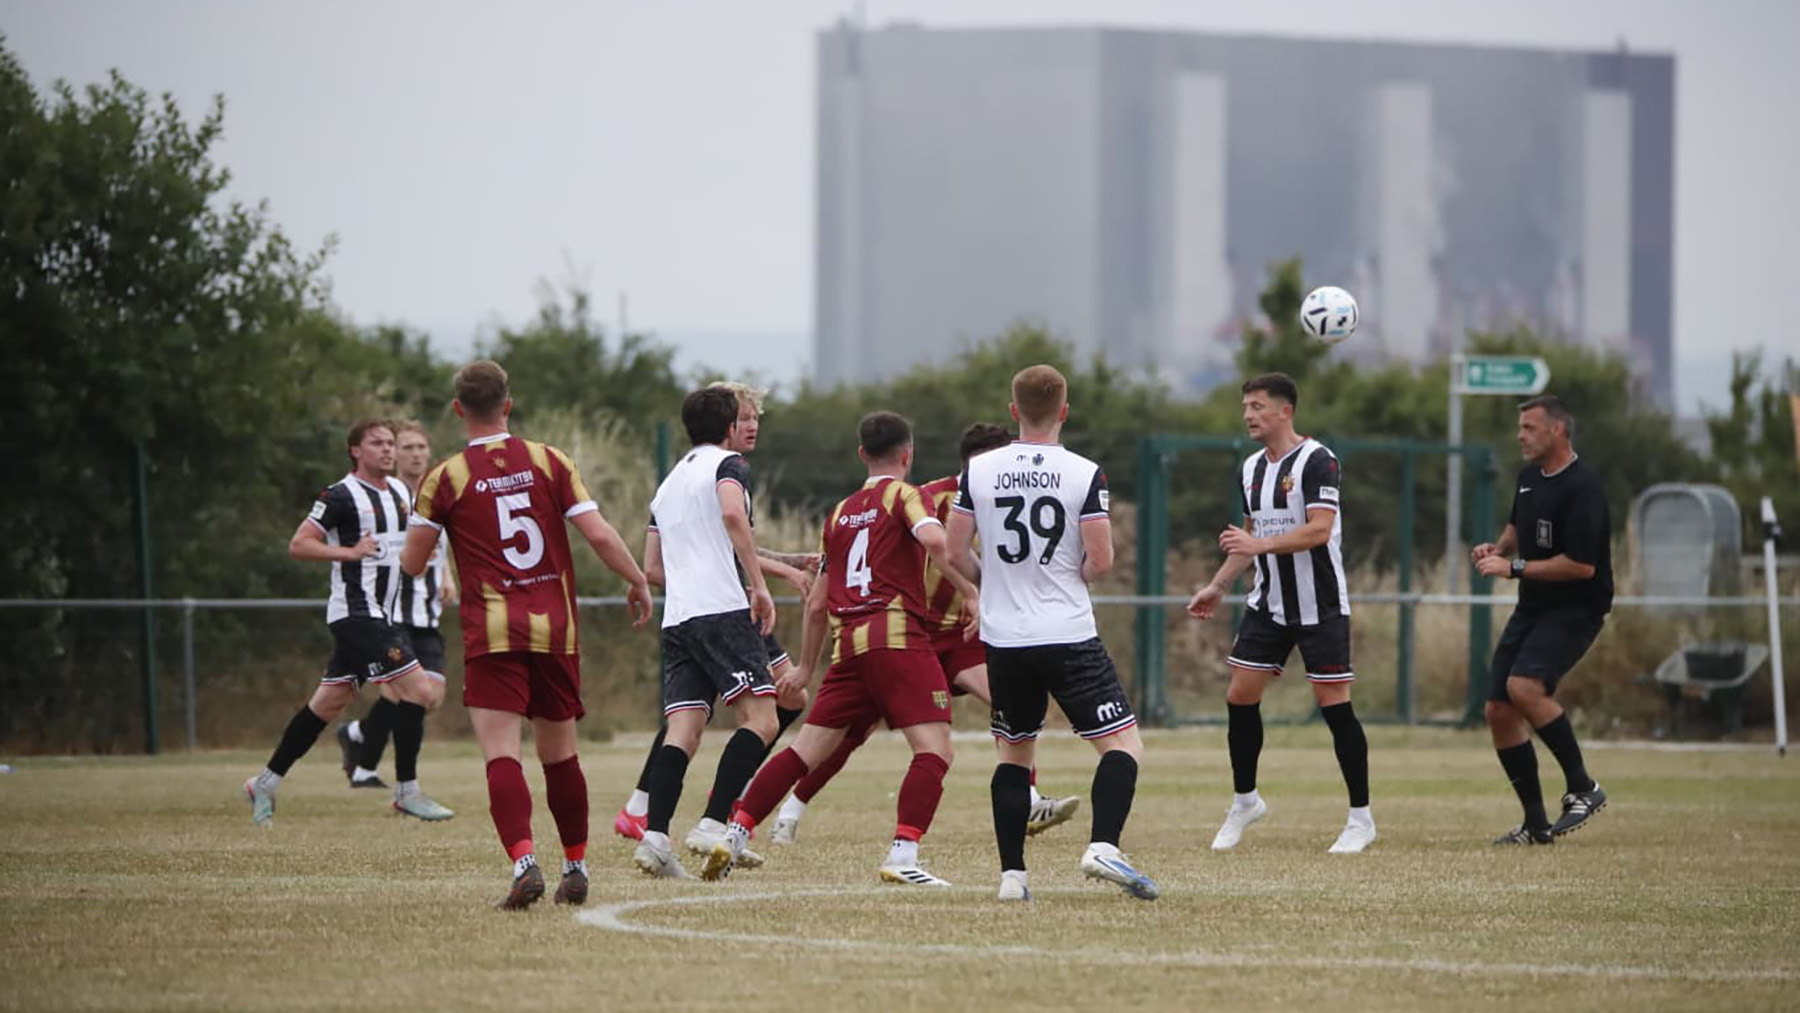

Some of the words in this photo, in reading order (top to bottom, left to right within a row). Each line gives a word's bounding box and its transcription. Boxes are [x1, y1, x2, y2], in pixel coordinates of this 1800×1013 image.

[994, 472, 1061, 490] JOHNSON
[495, 491, 545, 570] 5
[846, 527, 873, 597] 4
[995, 495, 1066, 565] 39
